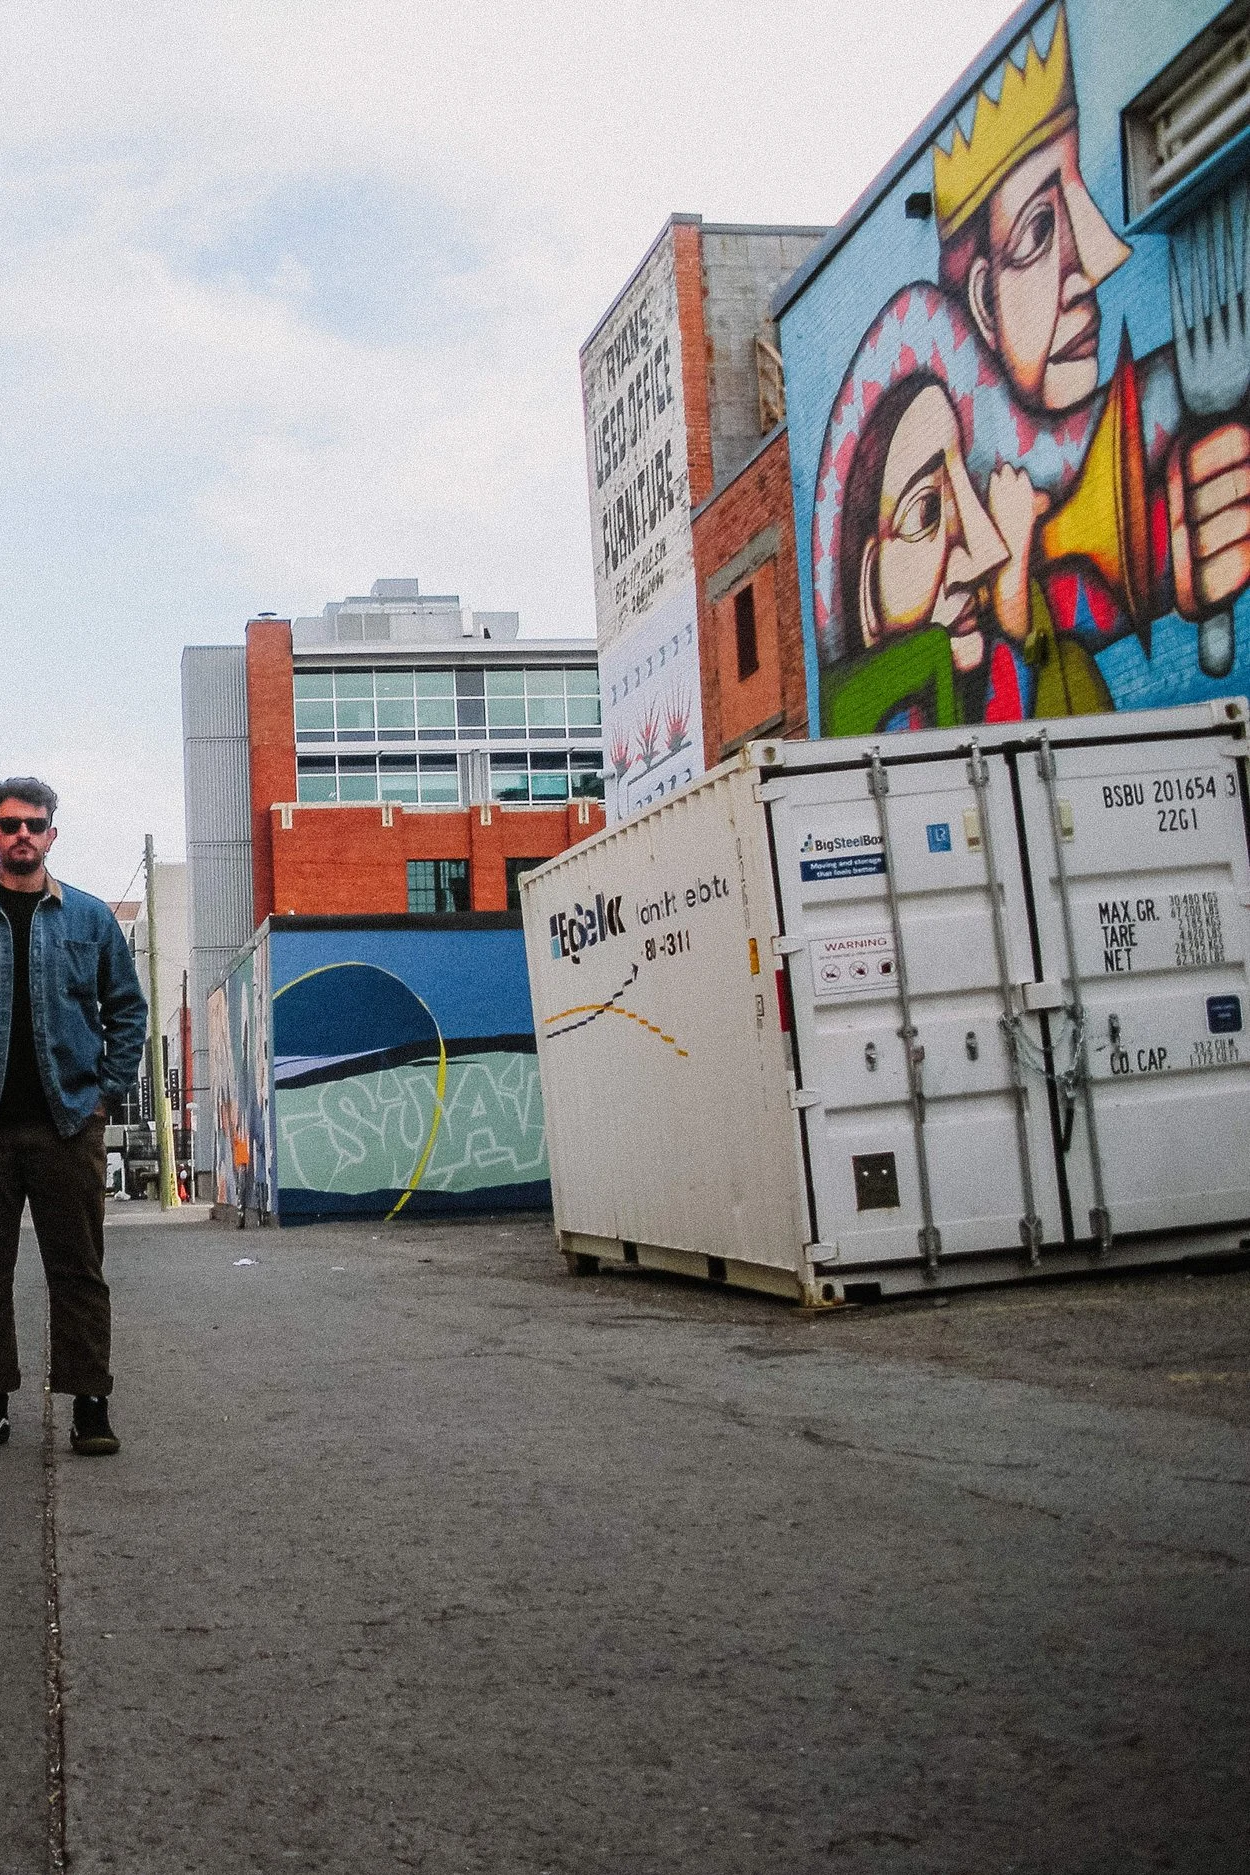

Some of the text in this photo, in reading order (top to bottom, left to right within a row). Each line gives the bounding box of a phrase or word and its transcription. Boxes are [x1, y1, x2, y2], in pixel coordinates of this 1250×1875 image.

[594, 335, 672, 490] USED OFFICE
[603, 438, 675, 580] FURNITURE
[1102, 773, 1237, 809] BSBU 201654 3
[1157, 807, 1198, 832] 22G1
[815, 834, 883, 853] BigSteelBox
[810, 857, 882, 870] Moving and storage
[816, 870, 833, 878] that
[824, 938, 887, 952] WARNING
[1101, 923, 1138, 948] TARE
[1103, 948, 1132, 972] NET
[1137, 1047, 1171, 1072] CAP.
